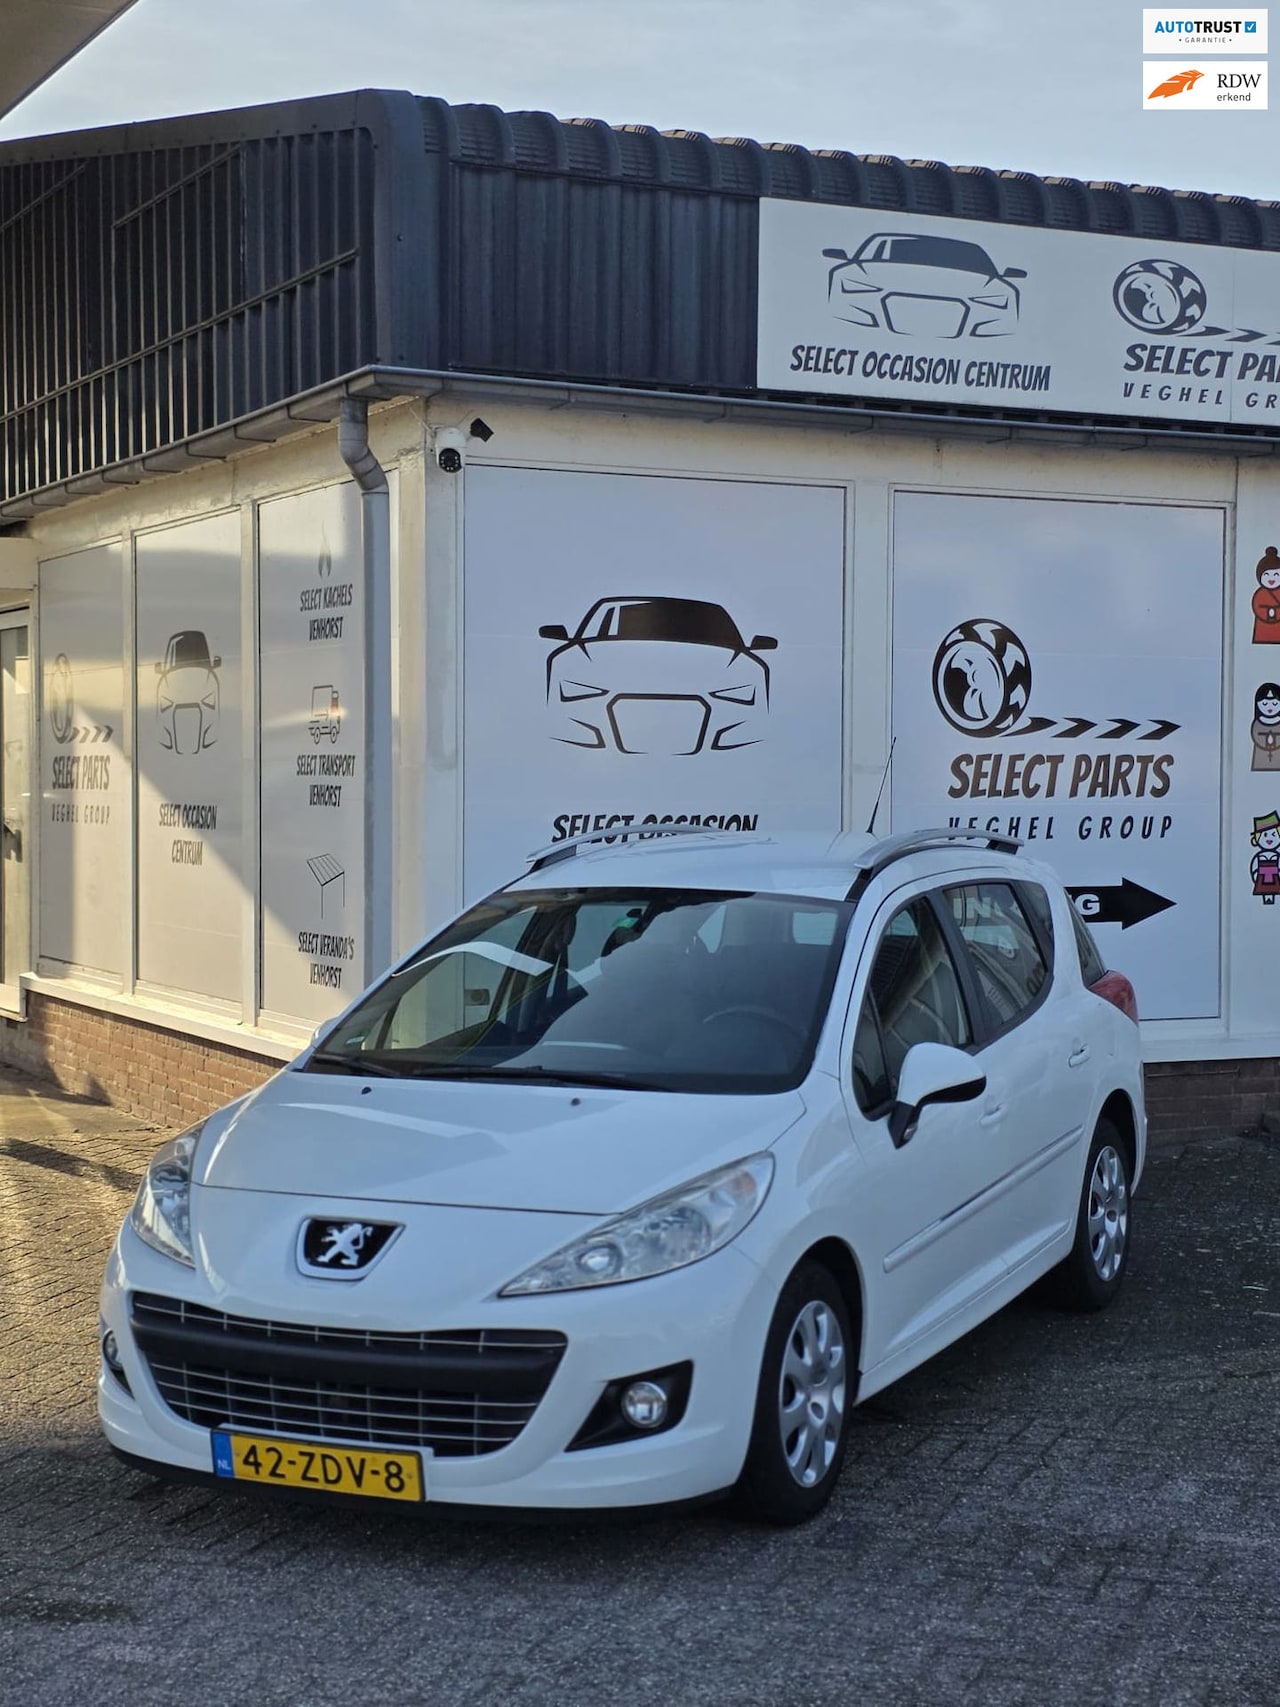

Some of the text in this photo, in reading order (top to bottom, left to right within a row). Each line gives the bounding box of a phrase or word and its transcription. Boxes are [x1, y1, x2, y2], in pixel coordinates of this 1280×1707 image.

[790, 344, 1052, 392] SELECT OCCASION CENTRUM
[1123, 343, 1280, 383] SELECT PA
[1123, 382, 1223, 405] VEGHEL
[300, 583, 353, 612] SELECT KACHELS
[309, 616, 344, 641] VENHORST
[52, 754, 111, 790] SELECT PARTS
[296, 753, 356, 777] SELECT TRANSPORT
[948, 753, 1175, 799] SELECT PARTS
[309, 784, 342, 808] VENHORST
[52, 804, 111, 824] VEGHEL GROUP
[159, 803, 218, 829] SELECT OCCASION
[948, 815, 1173, 841] VEGHEL GROUP
[171, 839, 204, 866] CENTRUM
[298, 931, 355, 961] SELECT VERANDA'S
[310, 962, 342, 989] VENHORST
[216, 1459, 231, 1470] NL
[242, 1444, 405, 1493] 42-ZDV-8
